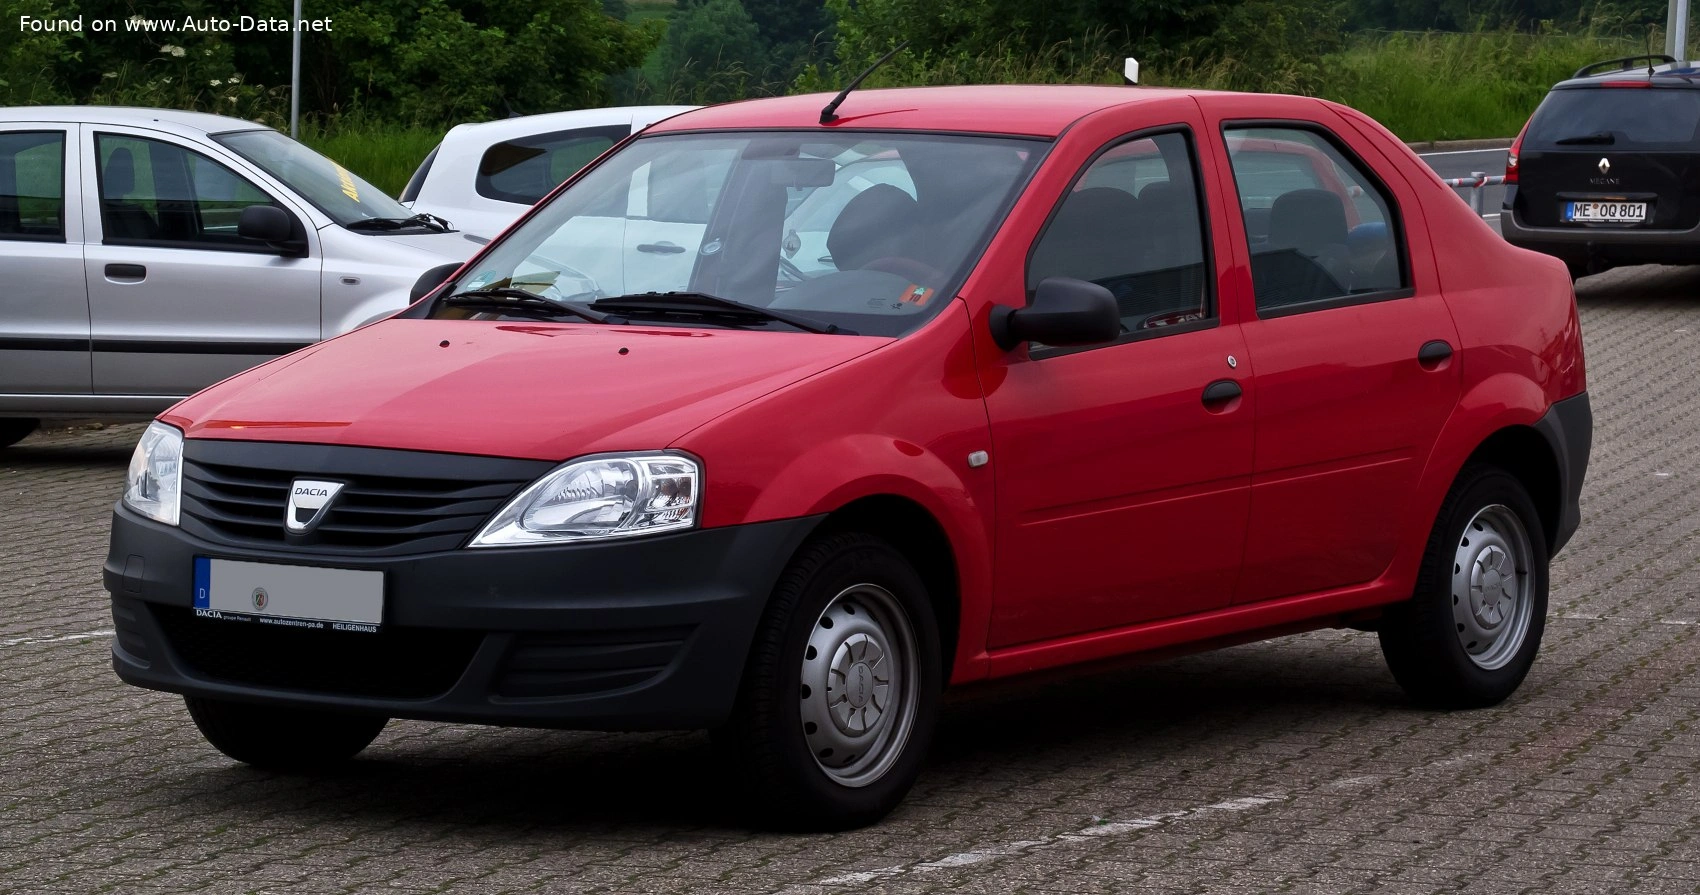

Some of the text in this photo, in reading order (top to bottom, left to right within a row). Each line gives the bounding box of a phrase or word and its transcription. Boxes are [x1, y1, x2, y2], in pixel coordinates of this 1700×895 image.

[1574, 203, 1643, 217] ME OQ 801
[294, 487, 328, 497] DACIA
[200, 588, 206, 599] D
[196, 609, 222, 619] DACIA
[260, 618, 323, 628] www.autozentren-pa.de
[333, 623, 377, 632] HEILIGENHAUS
